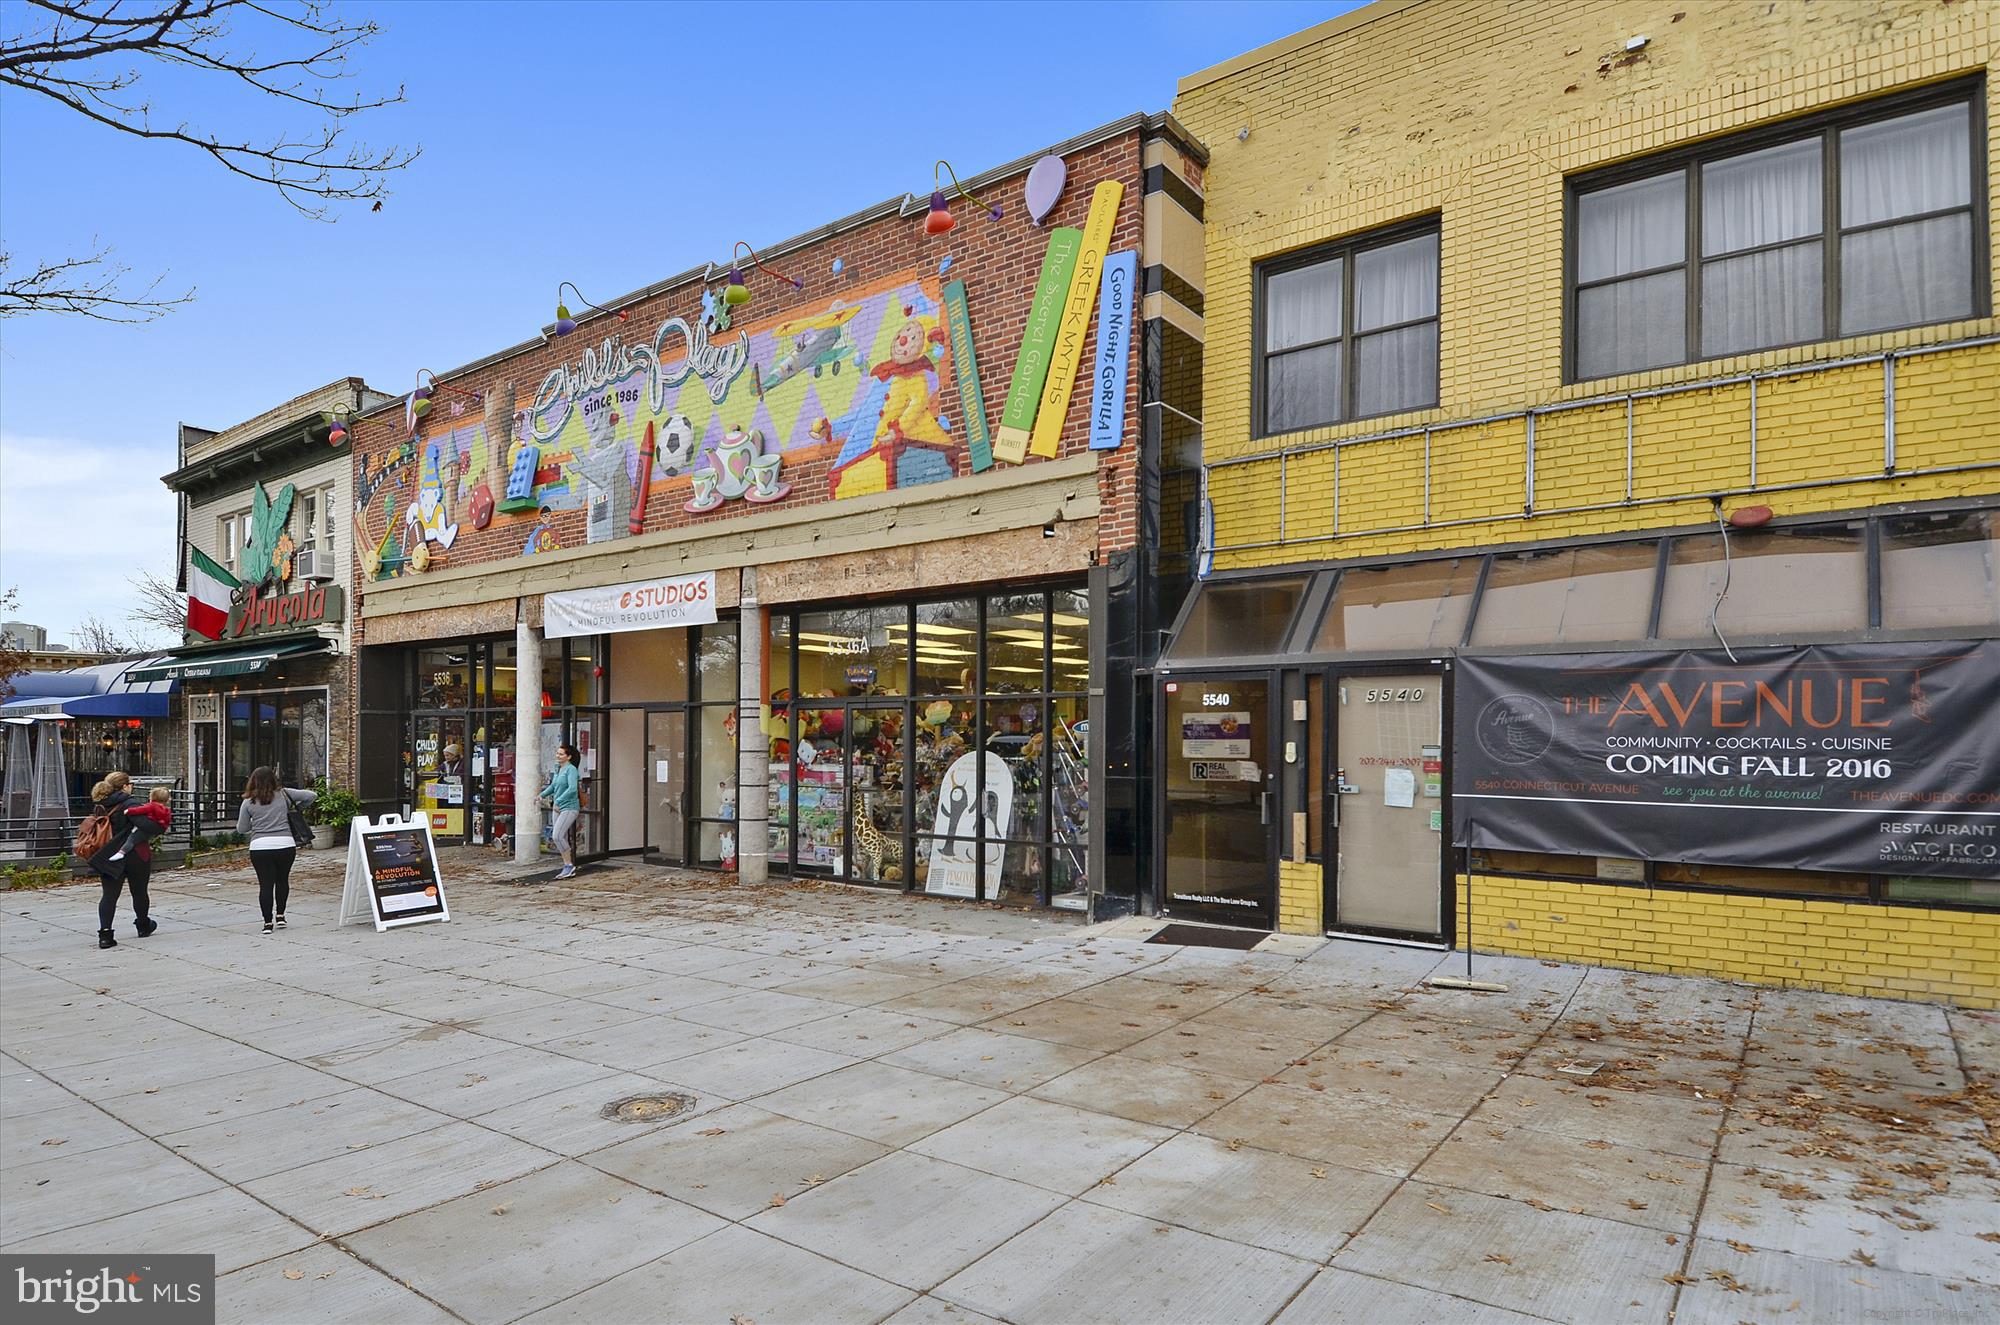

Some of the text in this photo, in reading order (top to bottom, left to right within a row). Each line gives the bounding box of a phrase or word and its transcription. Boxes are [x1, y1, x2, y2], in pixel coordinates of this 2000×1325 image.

[1050, 239, 1072, 276] The
[1111, 267, 1125, 310] GOOD
[949, 297, 961, 321] THE
[1049, 249, 1097, 405] GREEK MYTHS
[953, 323, 971, 379] PHANTOM
[528, 316, 749, 443] Child's Play
[1011, 350, 1041, 420] Garden
[584, 389, 639, 416] since 1986
[1098, 364, 1116, 431] GORILLA
[962, 377, 983, 443] TOLLBOOTH
[634, 580, 708, 608] STUDIOS
[236, 579, 326, 636] Arucola
[577, 616, 616, 627] MINDFUL
[621, 608, 686, 622] REVOLUTION
[434, 672, 450, 685] 5536
[1202, 694, 1230, 706] 5540
[1367, 689, 1422, 701] 5540
[1562, 695, 1607, 715] THE
[1608, 678, 1893, 729] AVENUE
[197, 698, 217, 719] 5534
[1606, 736, 1892, 750] COMMUNITY COCKTAILS CUISINE
[1606, 754, 1892, 778] COMING FALL 2016
[1475, 780, 1640, 794] 5540 CONNECTICUT AVENUE
[1662, 784, 1824, 801] see you at the avenue!
[1850, 790, 2000, 804] THEAVENUEDC.COM
[1880, 822, 1997, 836] RESTAURANT
[376, 871, 420, 880] REVOLUTION
[383, 866, 413, 874] MINDFUL
